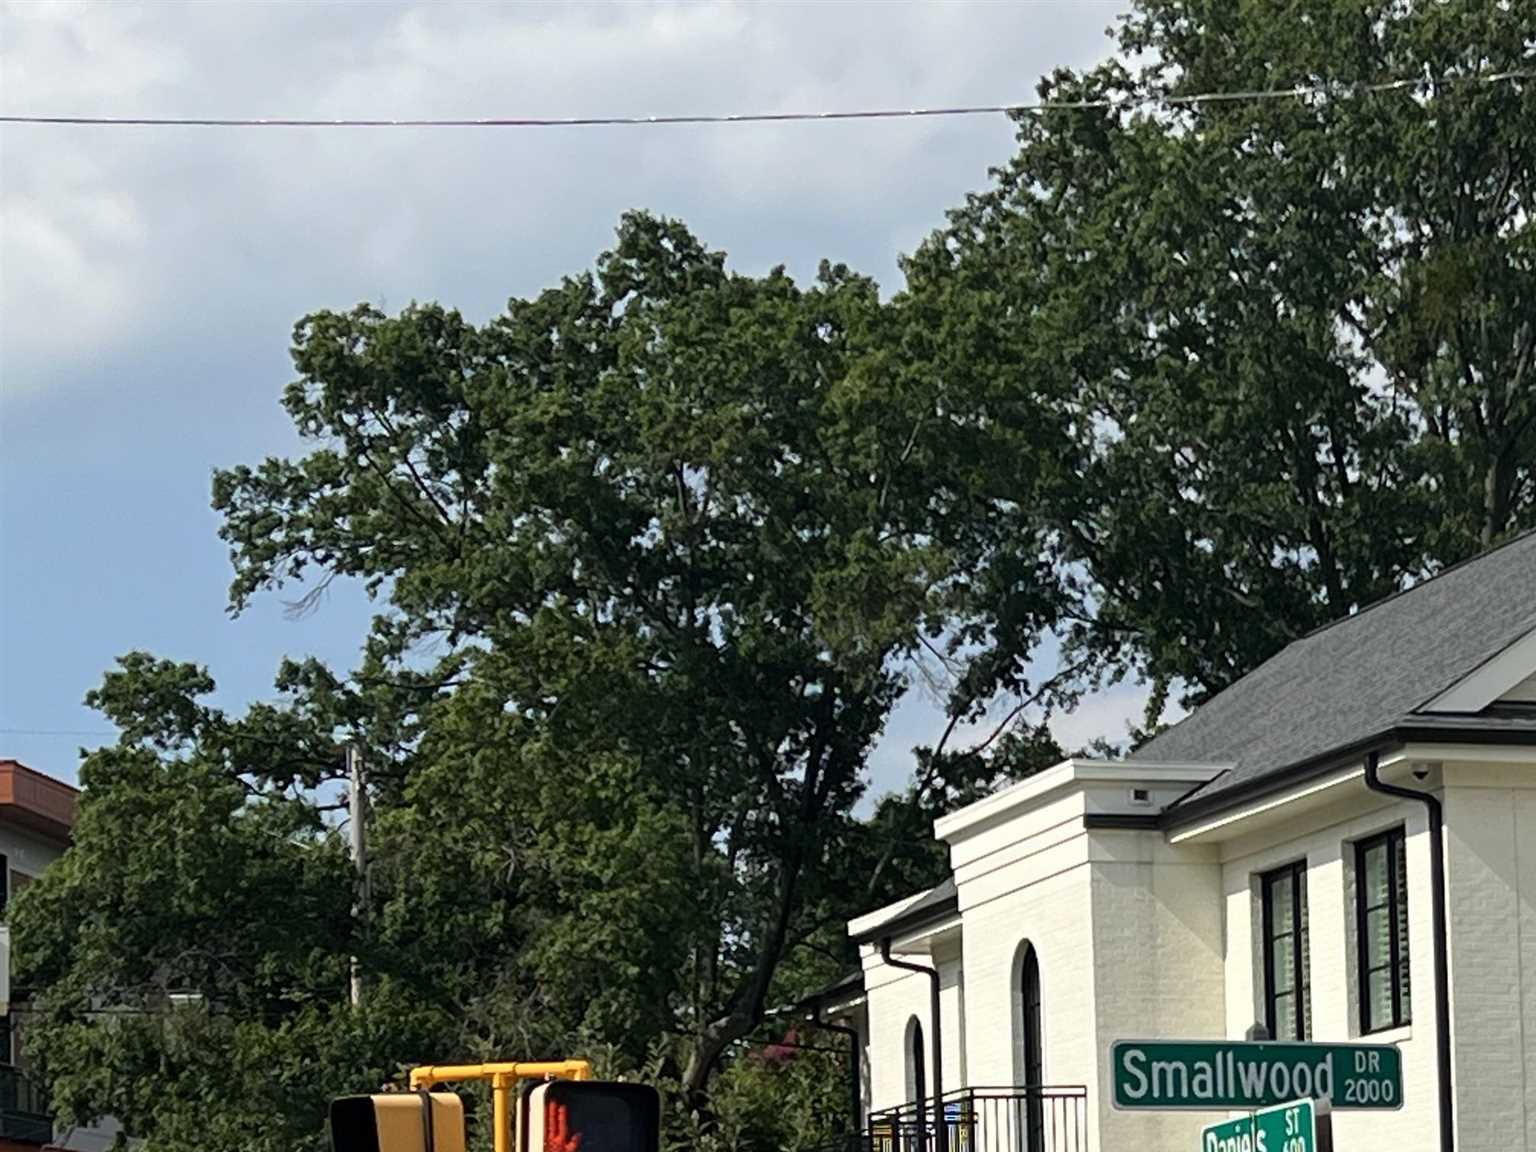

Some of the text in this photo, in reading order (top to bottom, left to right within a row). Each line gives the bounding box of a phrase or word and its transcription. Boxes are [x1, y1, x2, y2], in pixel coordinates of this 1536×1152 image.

[1122, 1049, 1334, 1099] Smallwood
[1355, 1050, 1381, 1073] DR
[1344, 1078, 1394, 1103] 2000
[1285, 1107, 1300, 1136] ST
